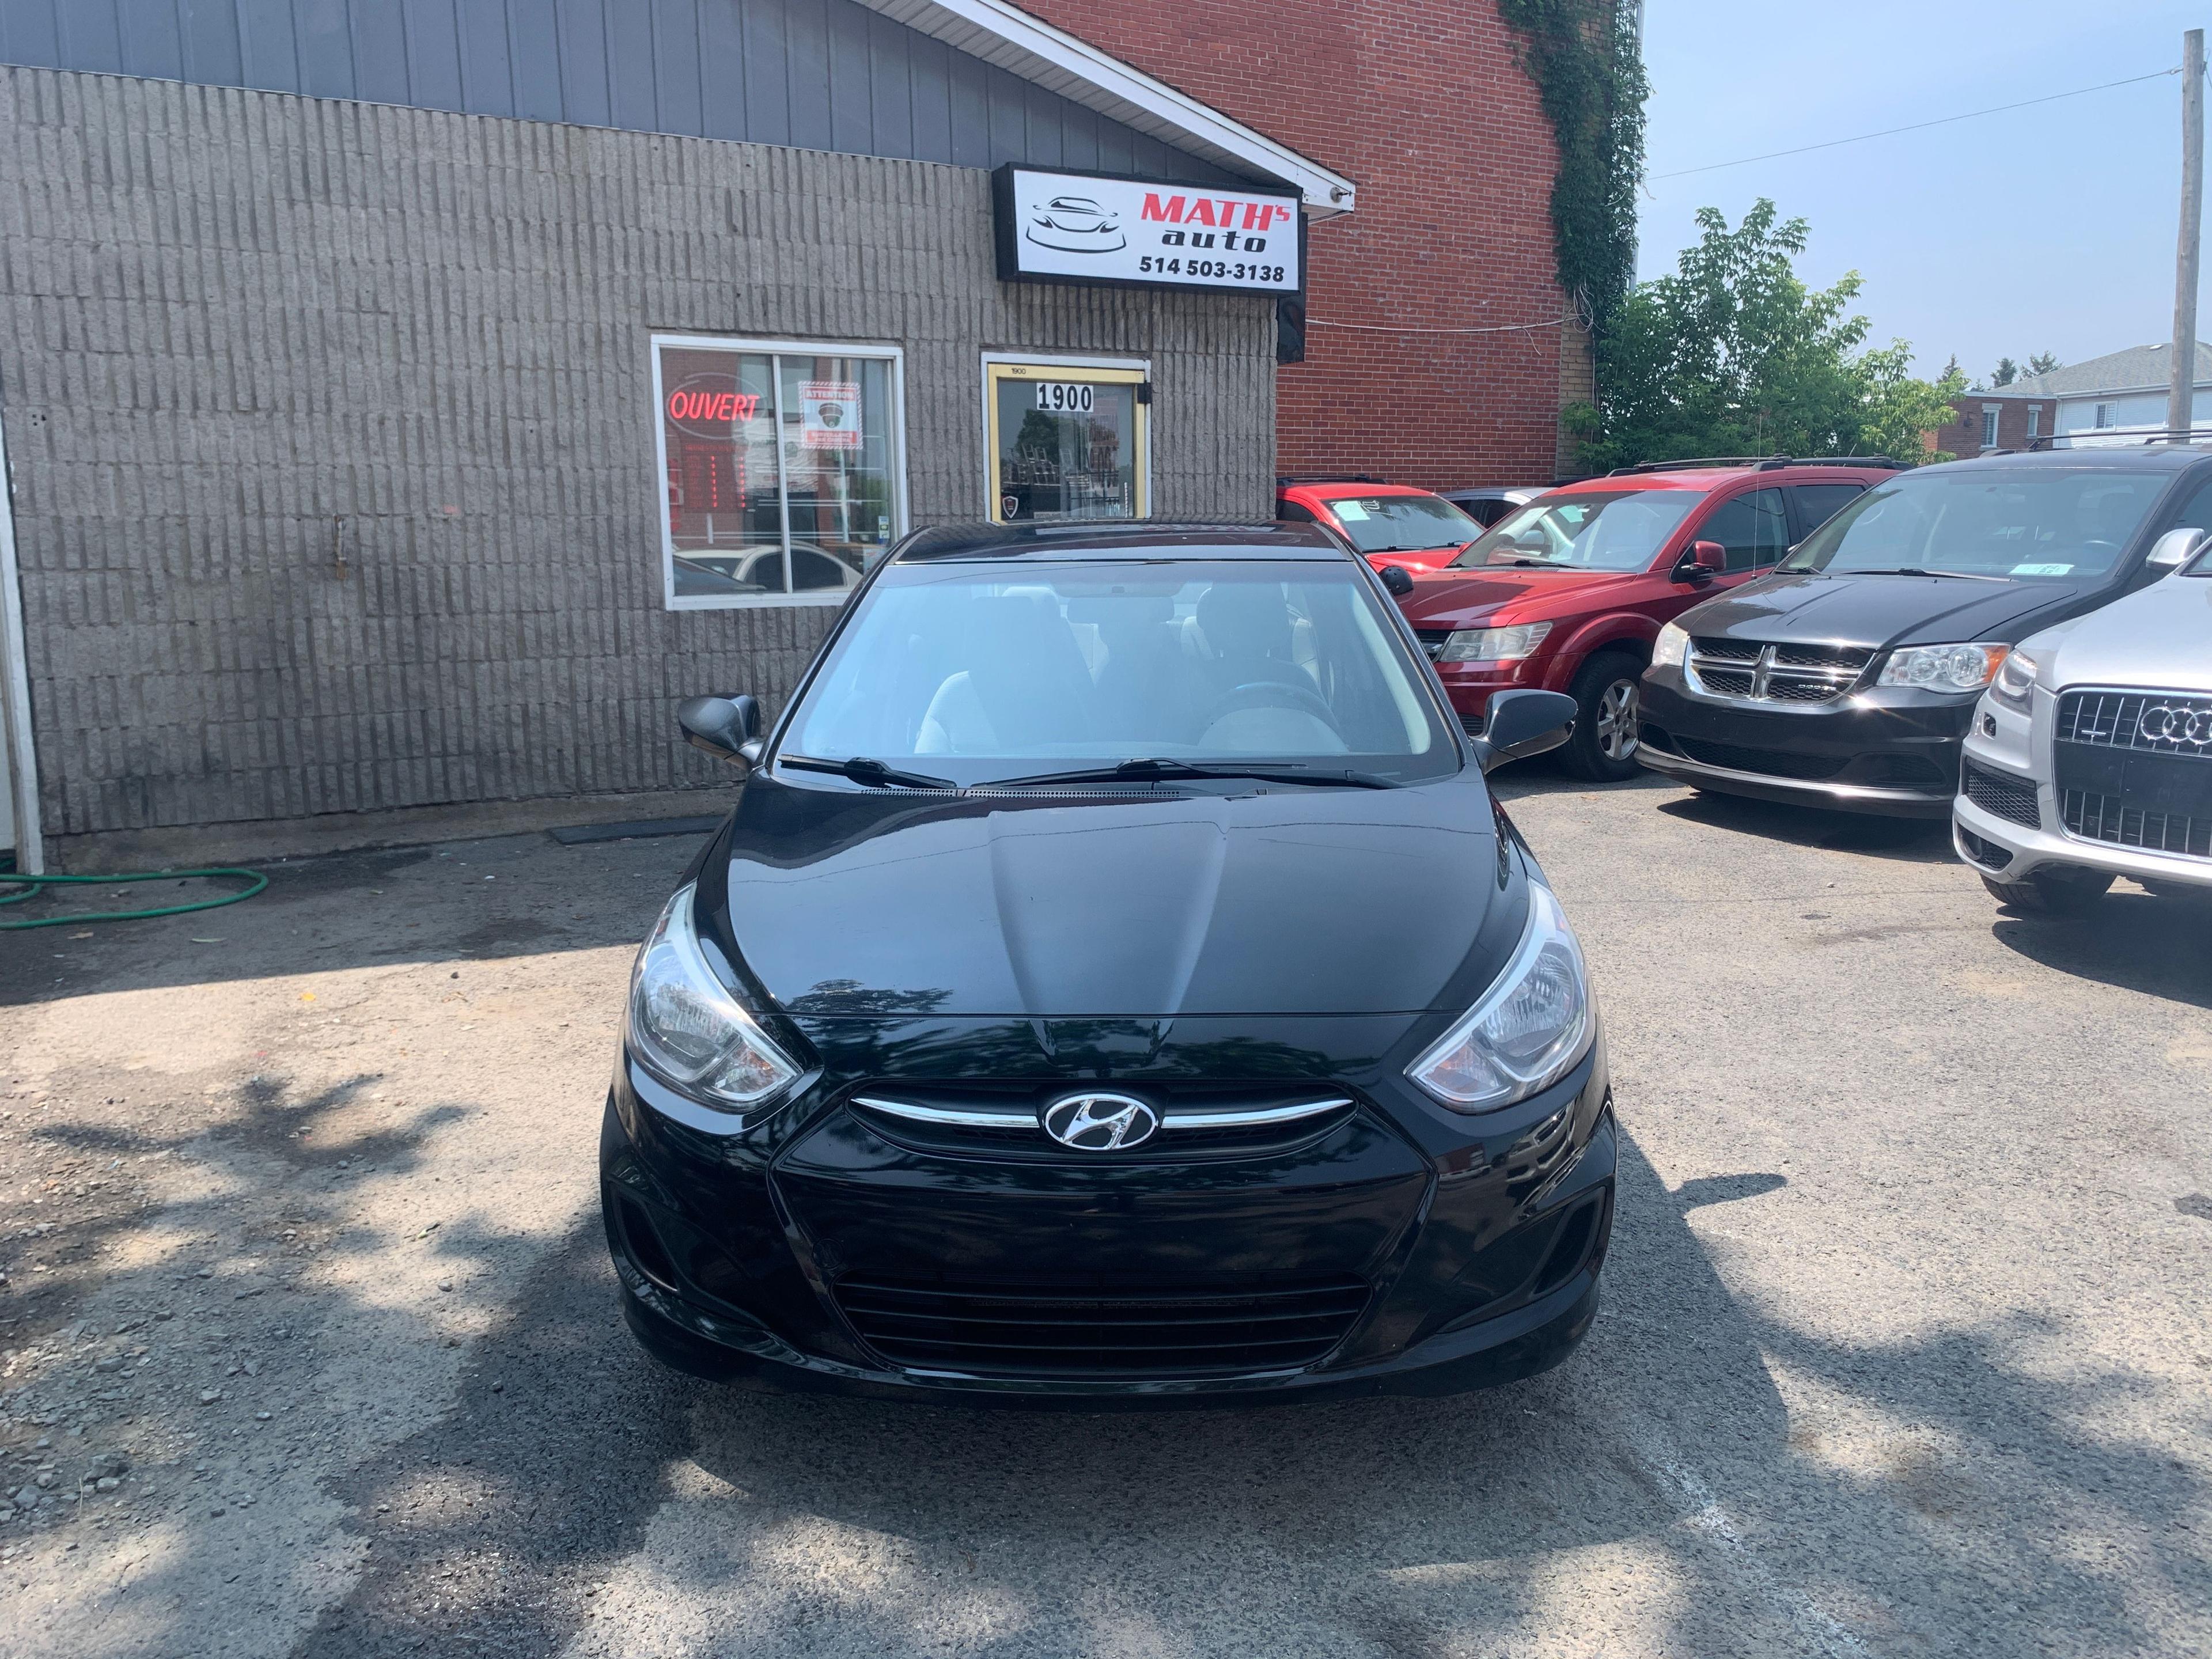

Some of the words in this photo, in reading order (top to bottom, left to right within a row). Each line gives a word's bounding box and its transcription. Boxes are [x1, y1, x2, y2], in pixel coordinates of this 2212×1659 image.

[1162, 229, 1267, 253] auto
[1139, 256, 1180, 275] 514
[1187, 260, 1285, 282] 503-3138
[671, 392, 761, 421] OUVERT
[1039, 384, 1092, 411] 1900
